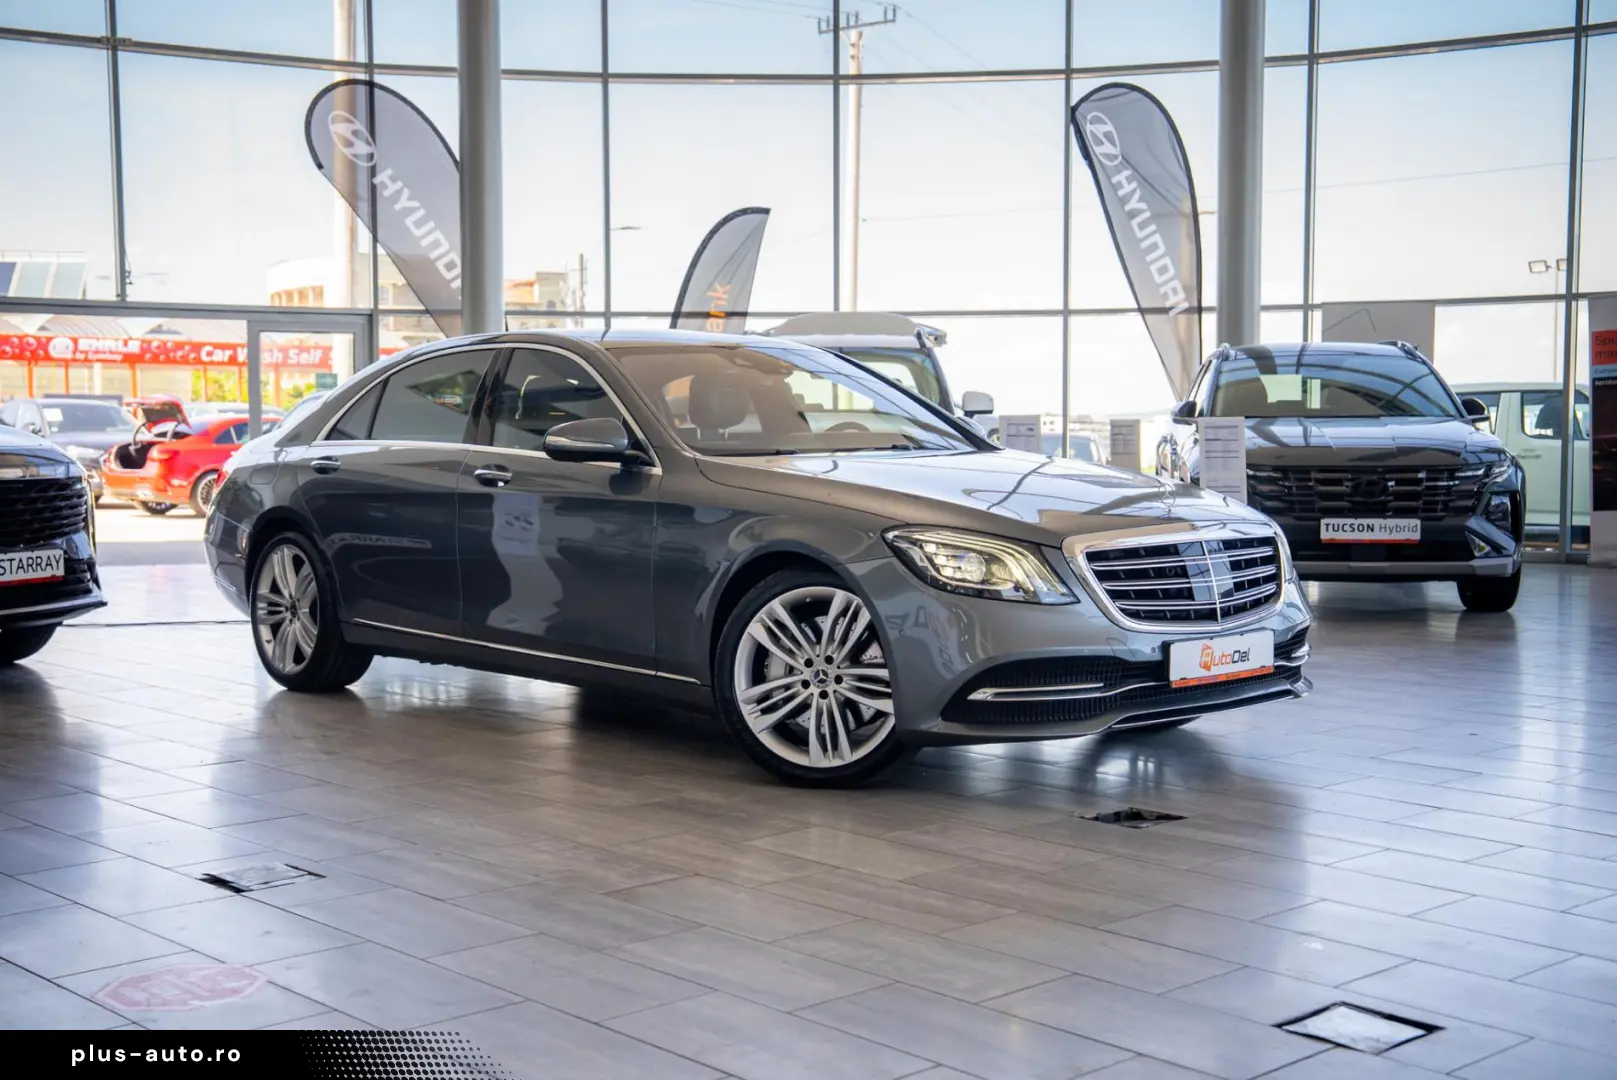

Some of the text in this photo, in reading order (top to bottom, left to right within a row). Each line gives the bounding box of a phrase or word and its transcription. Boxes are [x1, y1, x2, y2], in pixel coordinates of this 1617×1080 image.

[1111, 169, 1189, 316] HYUNDAI
[200, 345, 233, 362] Car
[287, 348, 324, 365] Self
[1324, 523, 1418, 535] TUCSON Hybrid
[0, 554, 62, 576] STARRAY
